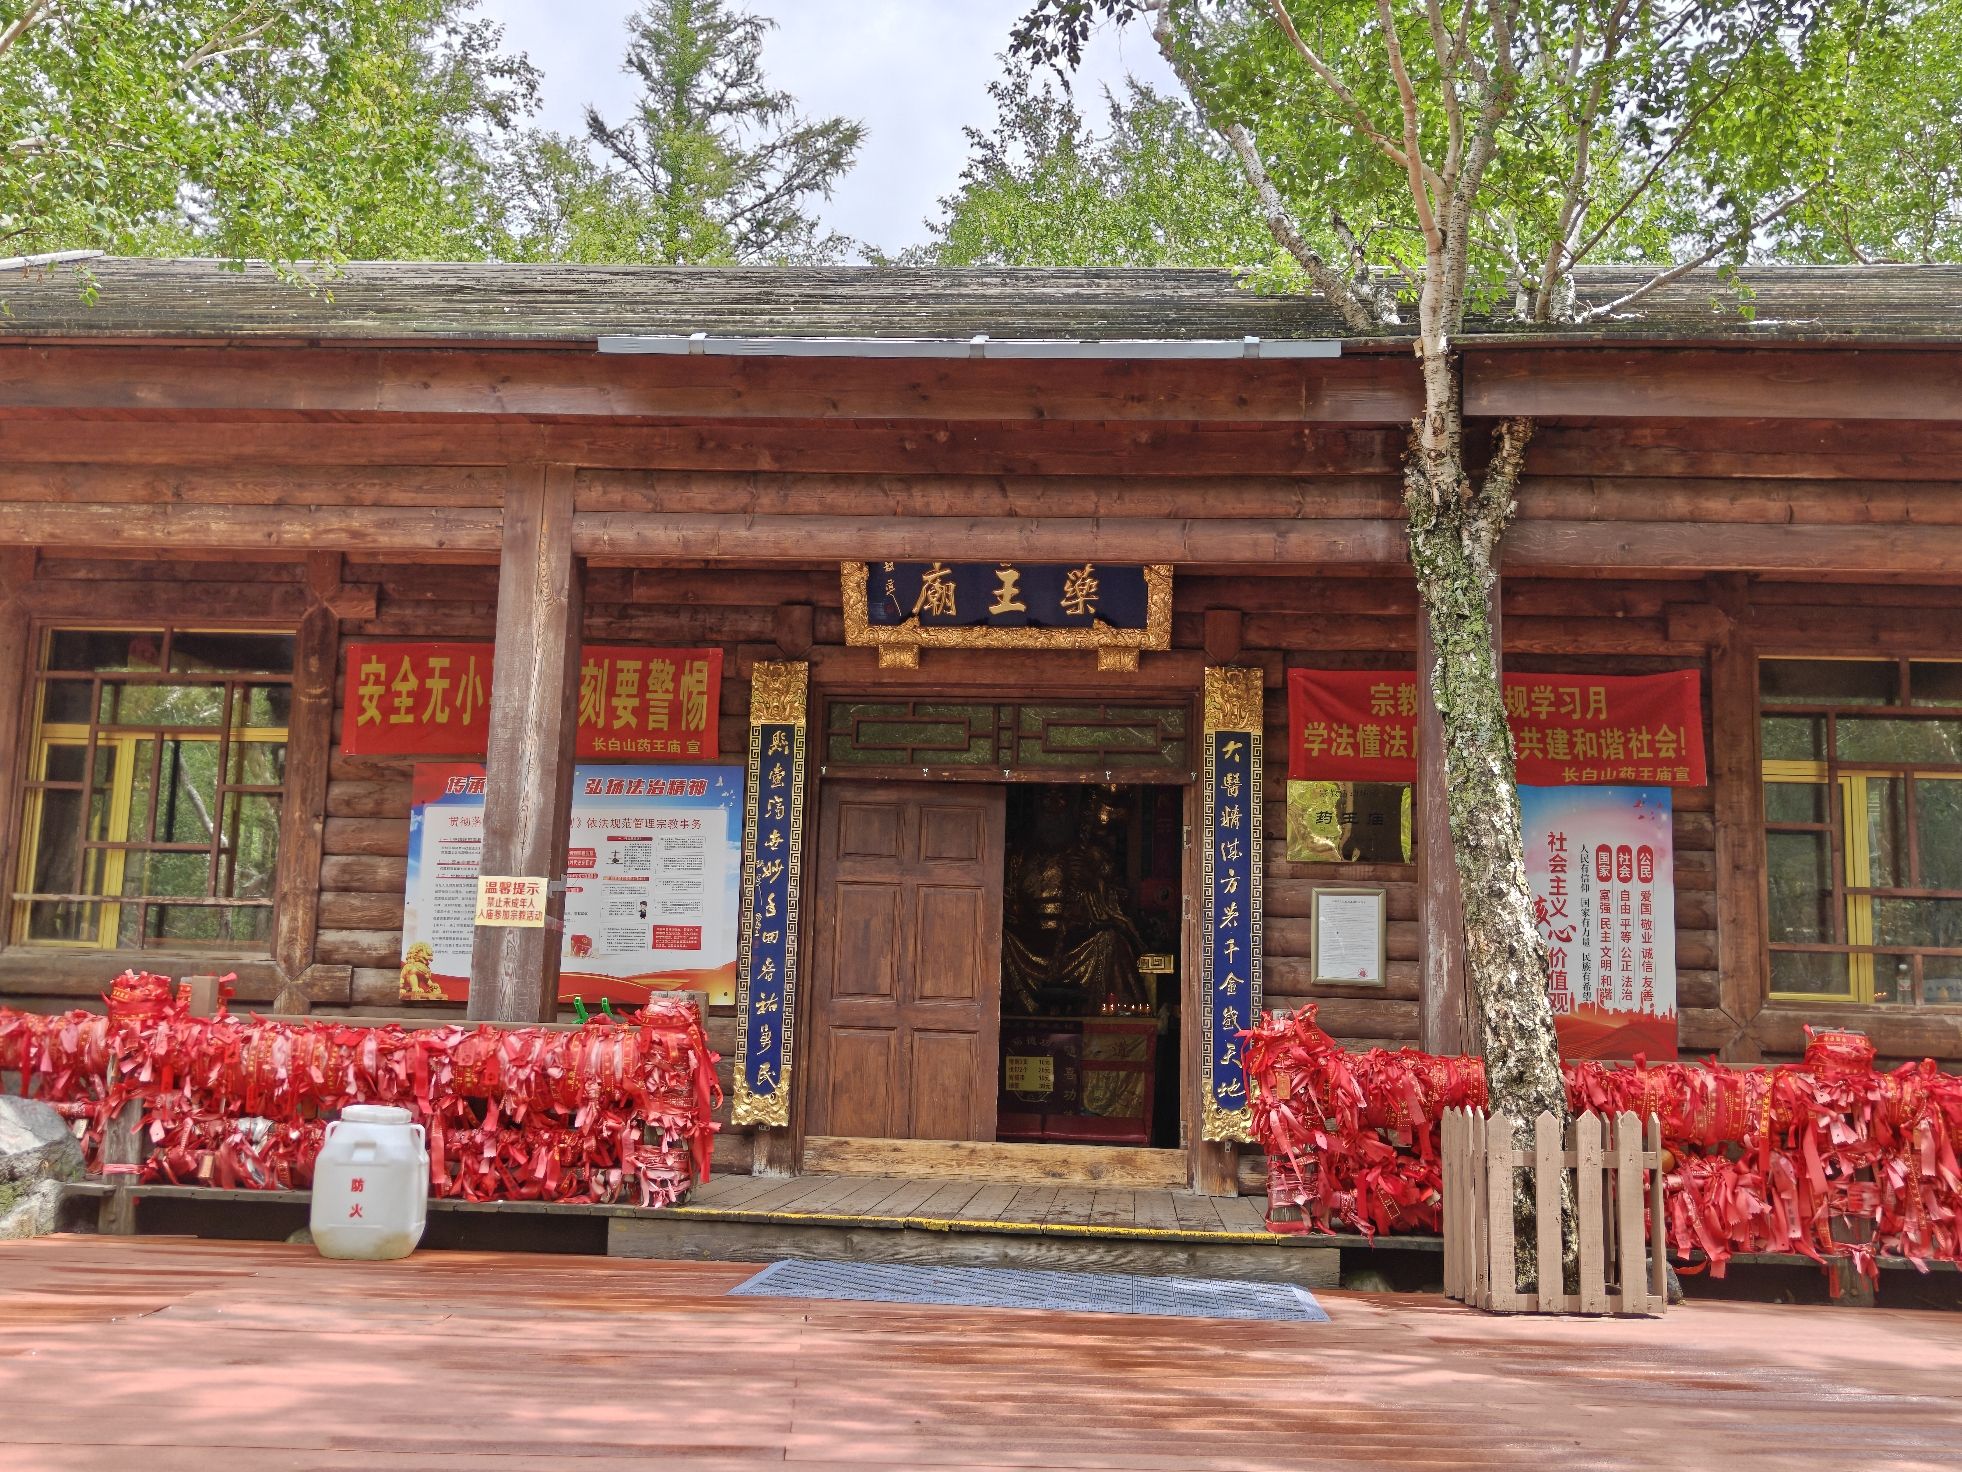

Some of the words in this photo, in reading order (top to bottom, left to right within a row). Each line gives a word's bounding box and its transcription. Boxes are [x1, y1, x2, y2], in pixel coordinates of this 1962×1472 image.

[357, 654, 486, 727] 安全无小
[578, 658, 709, 732] 刻要警惕
[592, 737, 680, 753] 长白山药王庙
[686, 740, 700, 754] 宣
[1562, 766, 1690, 782] 长白山药王庙宣
[584, 778, 708, 797] 弘扬法治精神
[1315, 810, 1384, 825] 药王庙
[1580, 843, 1590, 893] 人民有信仰
[1598, 852, 1611, 877] 国家
[1618, 852, 1631, 878] 社会
[1639, 852, 1651, 878] 公民
[485, 881, 540, 895] 温馨提示
[486, 897, 536, 909] 禁止未成年人
[1580, 897, 1590, 948] 国家有力量
[1581, 951, 1592, 1001] 民族有希望
[348, 1177, 366, 1219] 防火
